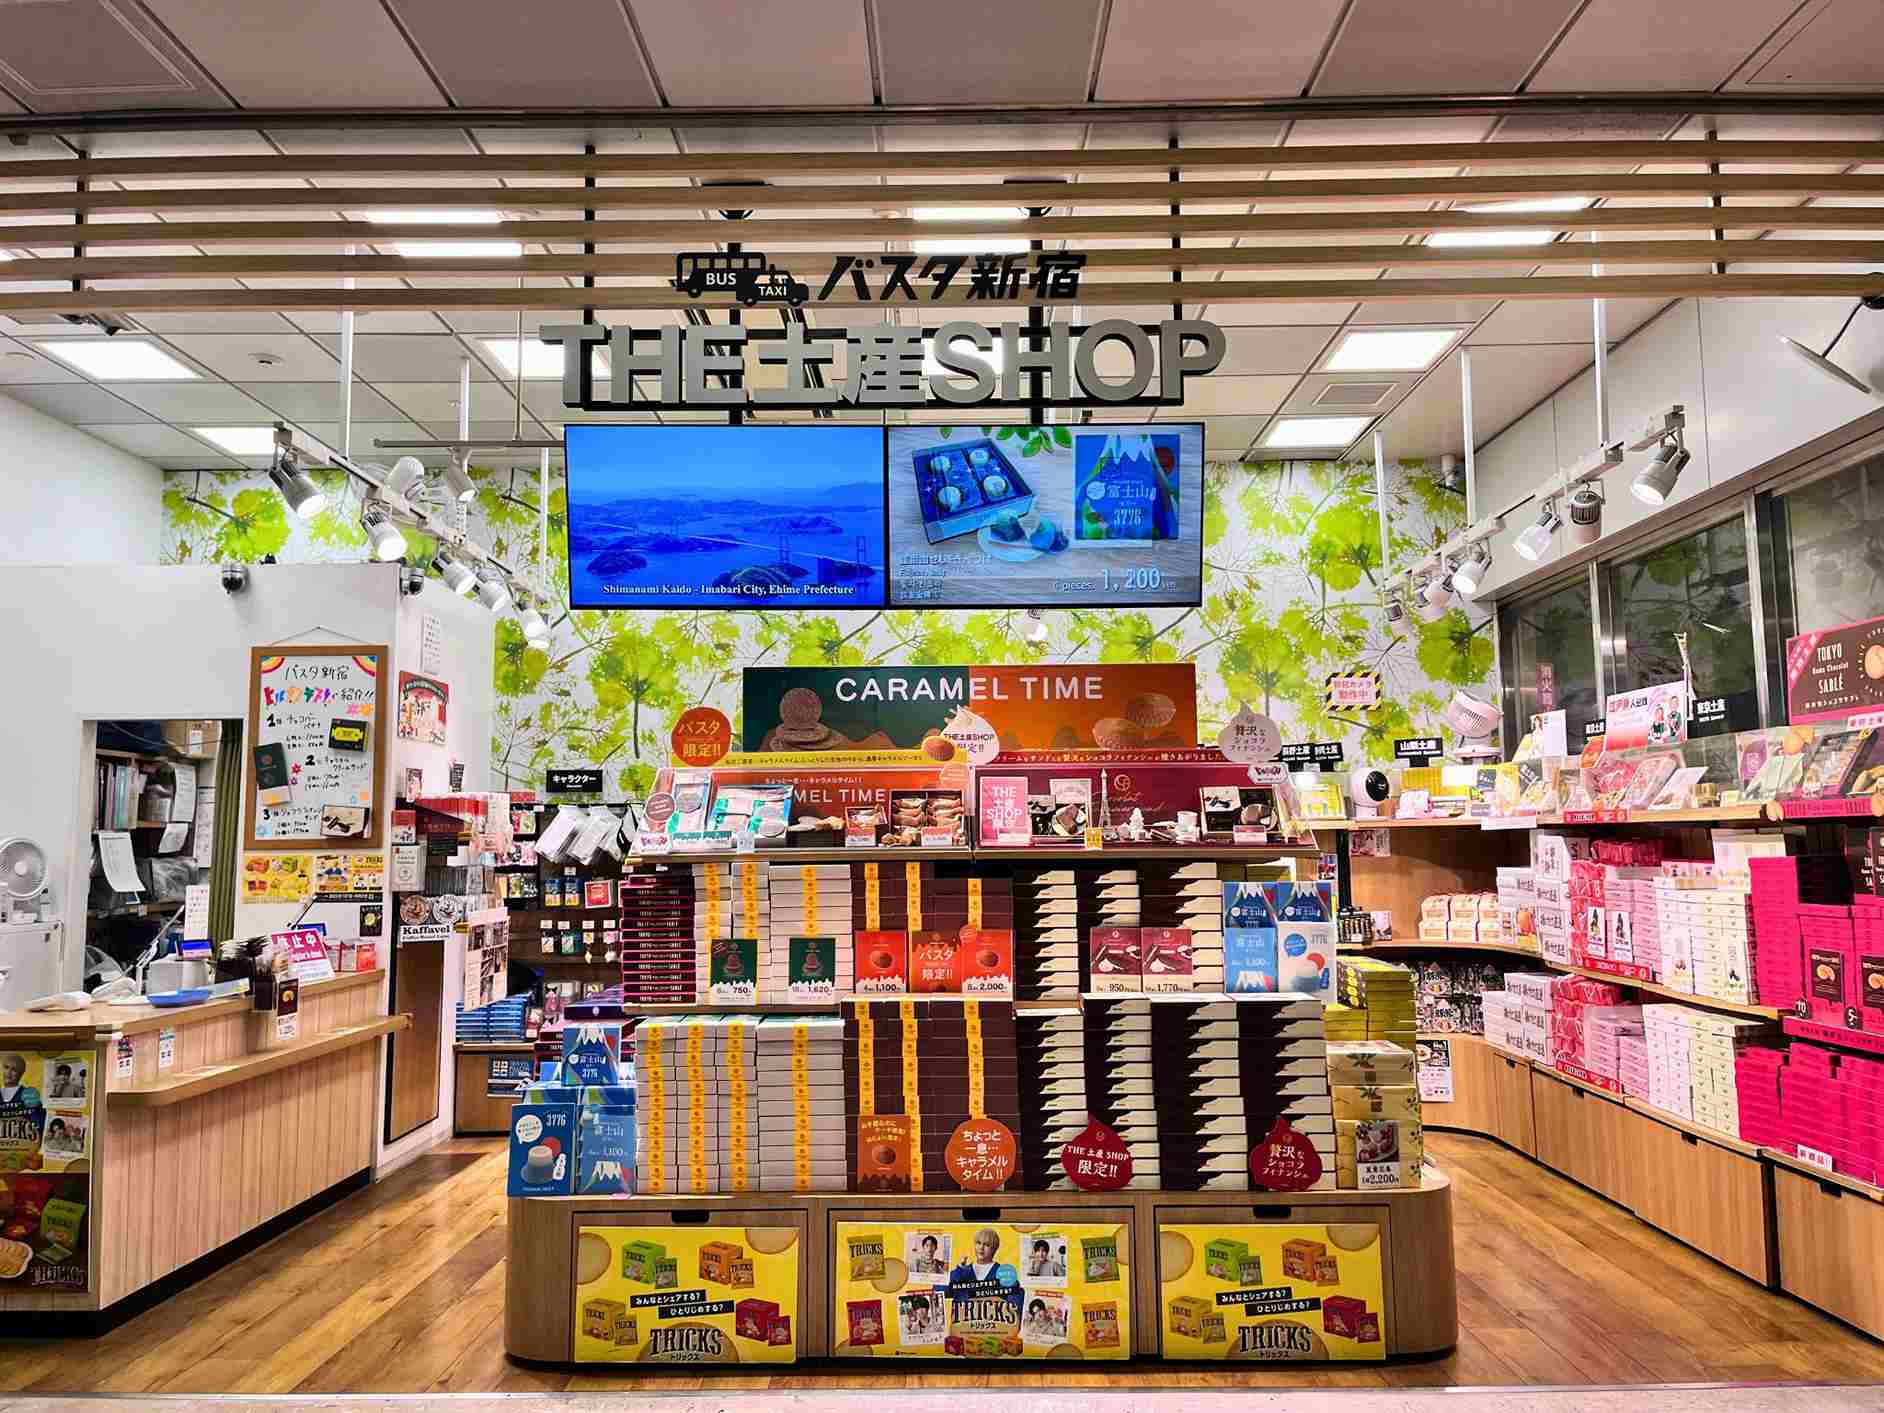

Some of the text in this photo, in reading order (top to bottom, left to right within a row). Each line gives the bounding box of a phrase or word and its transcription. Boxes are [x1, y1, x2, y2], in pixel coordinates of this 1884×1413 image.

[705, 273, 737, 286] BUS
[817, 251, 1087, 300] バスタ新宿
[758, 286, 788, 297] TAXI
[603, 584, 661, 594] Shimanami
[662, 584, 692, 594] Kaido
[701, 584, 741, 594] Imabari
[743, 584, 767, 596] City,
[769, 584, 801, 594] Ehime
[803, 584, 854, 594] Prefecture
[1817, 642, 1842, 662] TOKYO
[835, 676, 1104, 701] CARAMEL TIME
[678, 719, 720, 735] バスタ
[552, 774, 597, 784] キャラクター
[839, 789, 885, 802] TIME
[992, 787, 1016, 798] THE
[987, 809, 1022, 818] SHOP
[919, 948, 953, 961] バスタ
[545, 1113, 566, 1127] 3776
[0, 1116, 40, 1142] ICKS
[963, 1129, 1001, 1142] ちょっと
[956, 1155, 1008, 1168] キャラメル
[1105, 1151, 1129, 1161] SHOP
[951, 1299, 1018, 1325] TRICKS
[650, 1327, 723, 1356] TRICKS
[1238, 1325, 1313, 1353] TRICKS
